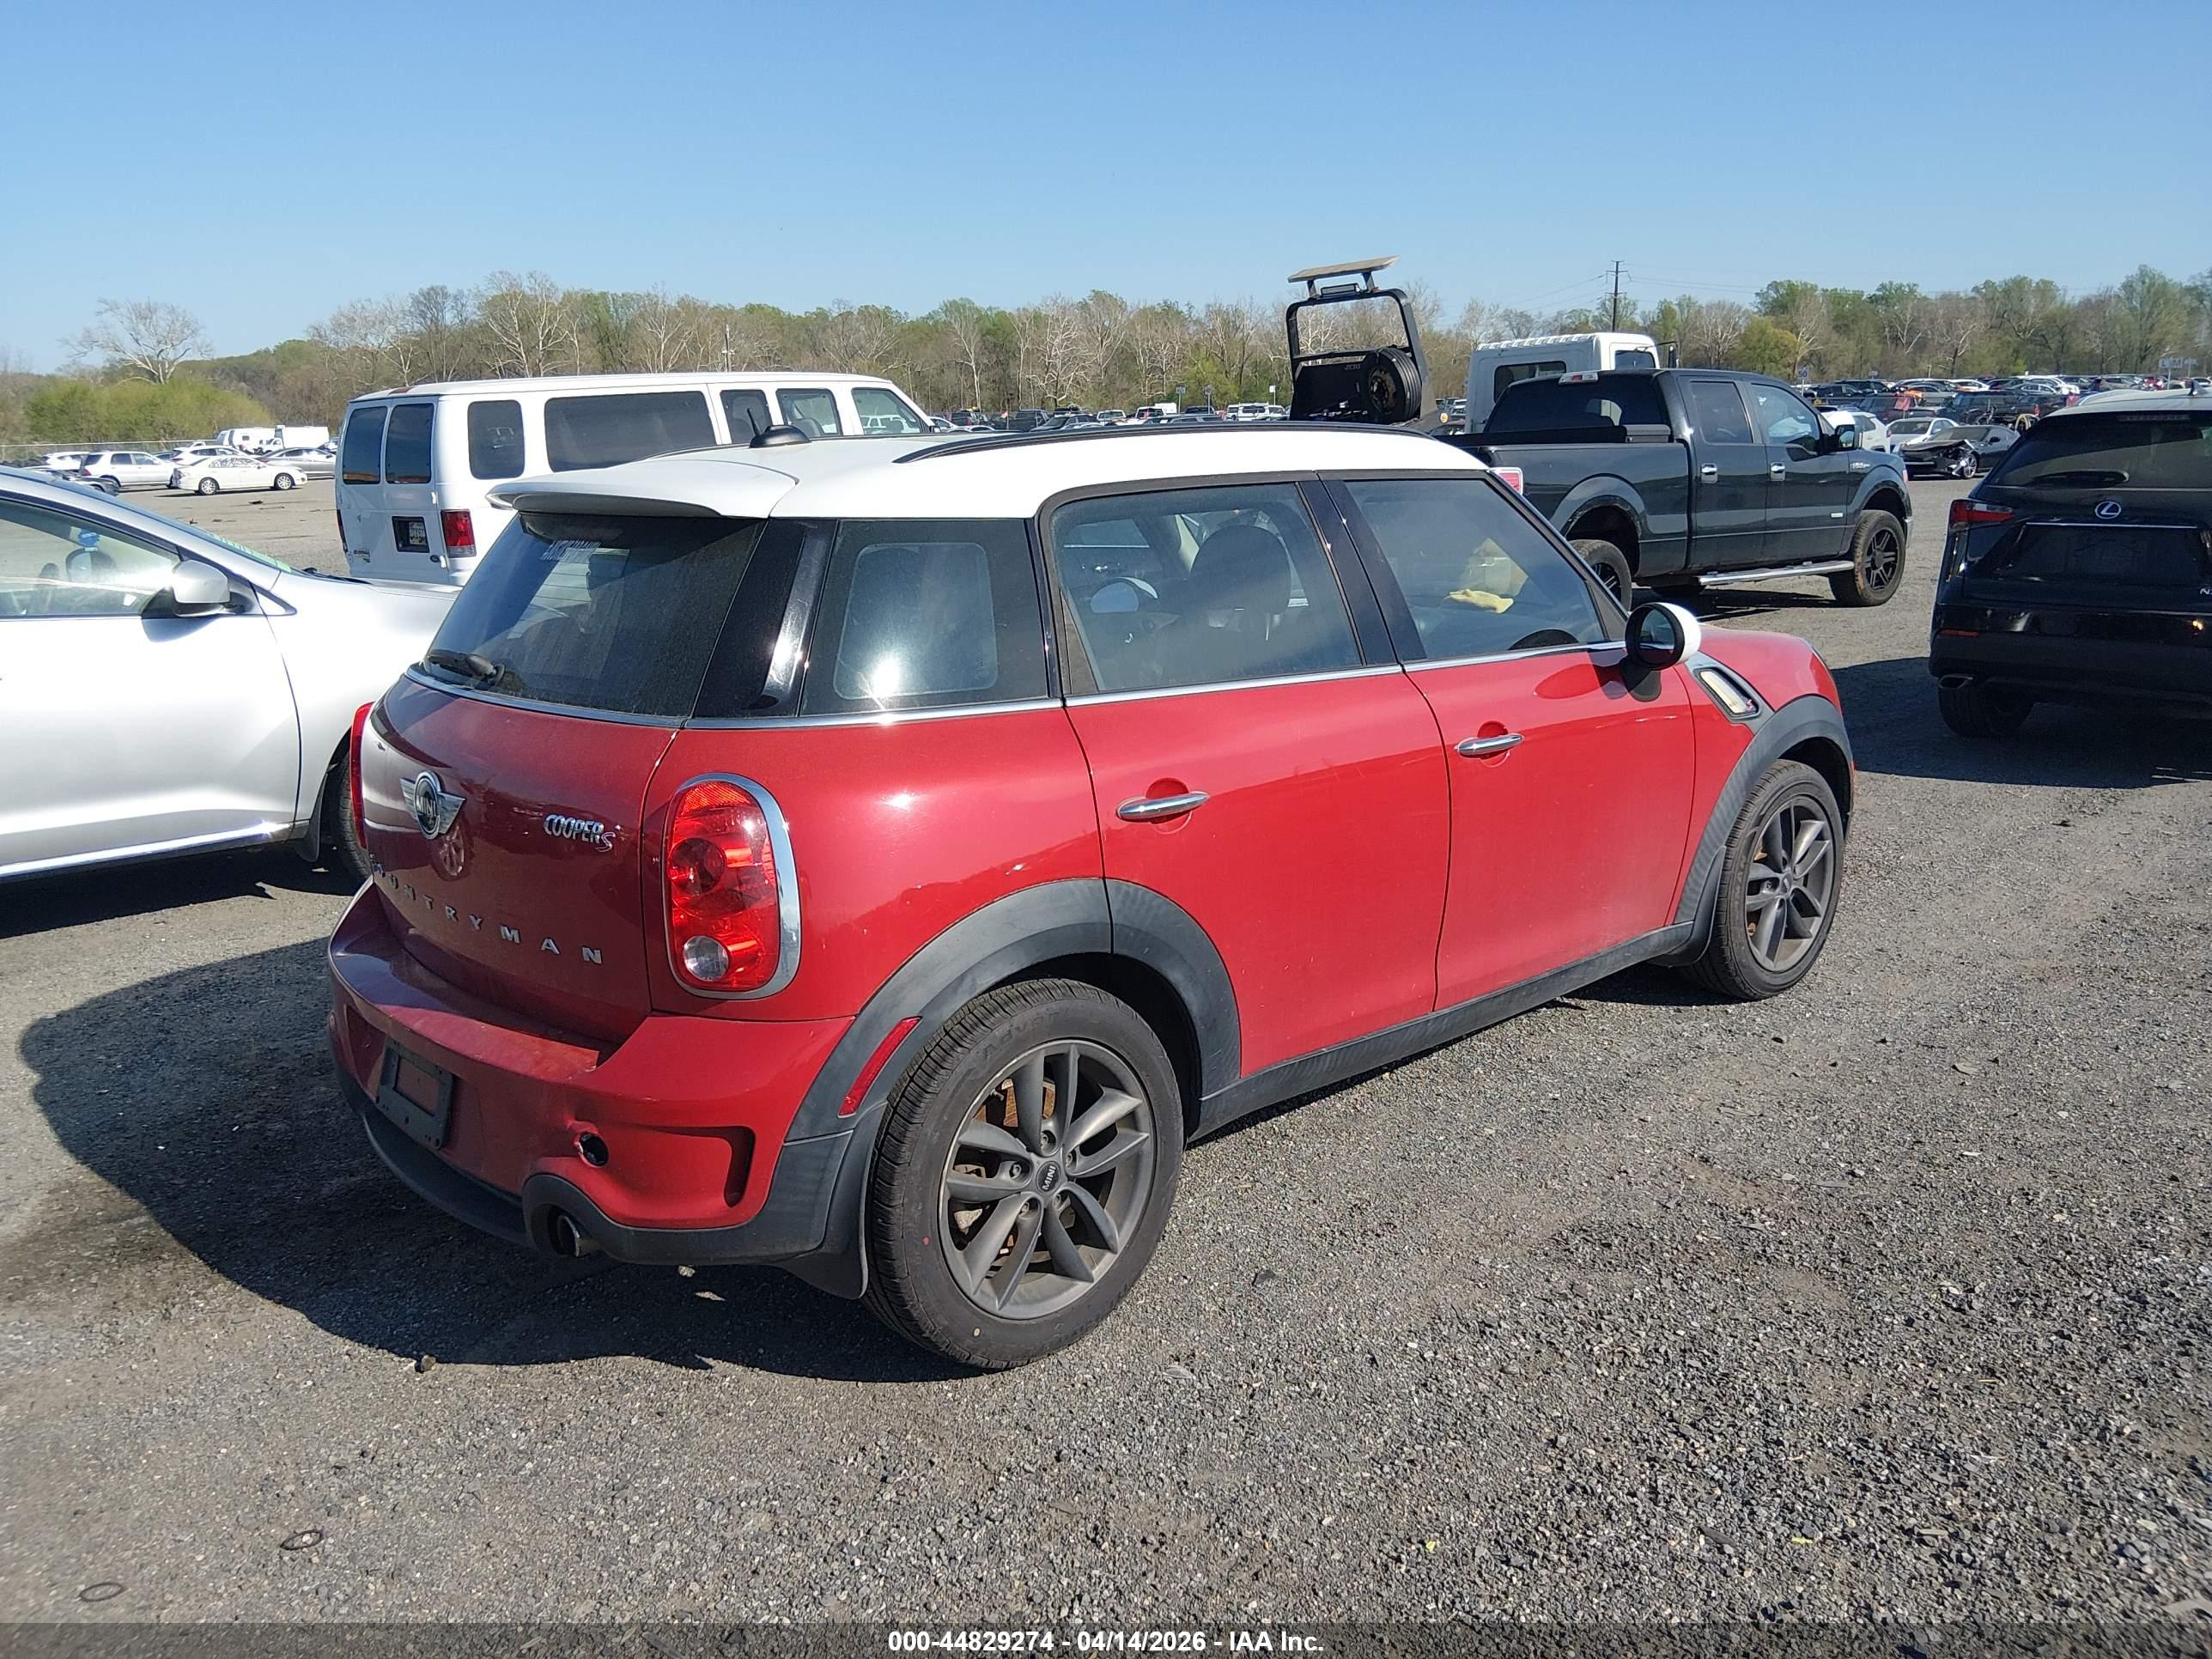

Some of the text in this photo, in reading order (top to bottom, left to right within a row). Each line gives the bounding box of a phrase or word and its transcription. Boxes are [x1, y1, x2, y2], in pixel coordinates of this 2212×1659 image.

[416, 795, 438, 817] MINI
[543, 814, 616, 852] COOPER S
[1042, 1165, 1056, 1190] MINI
